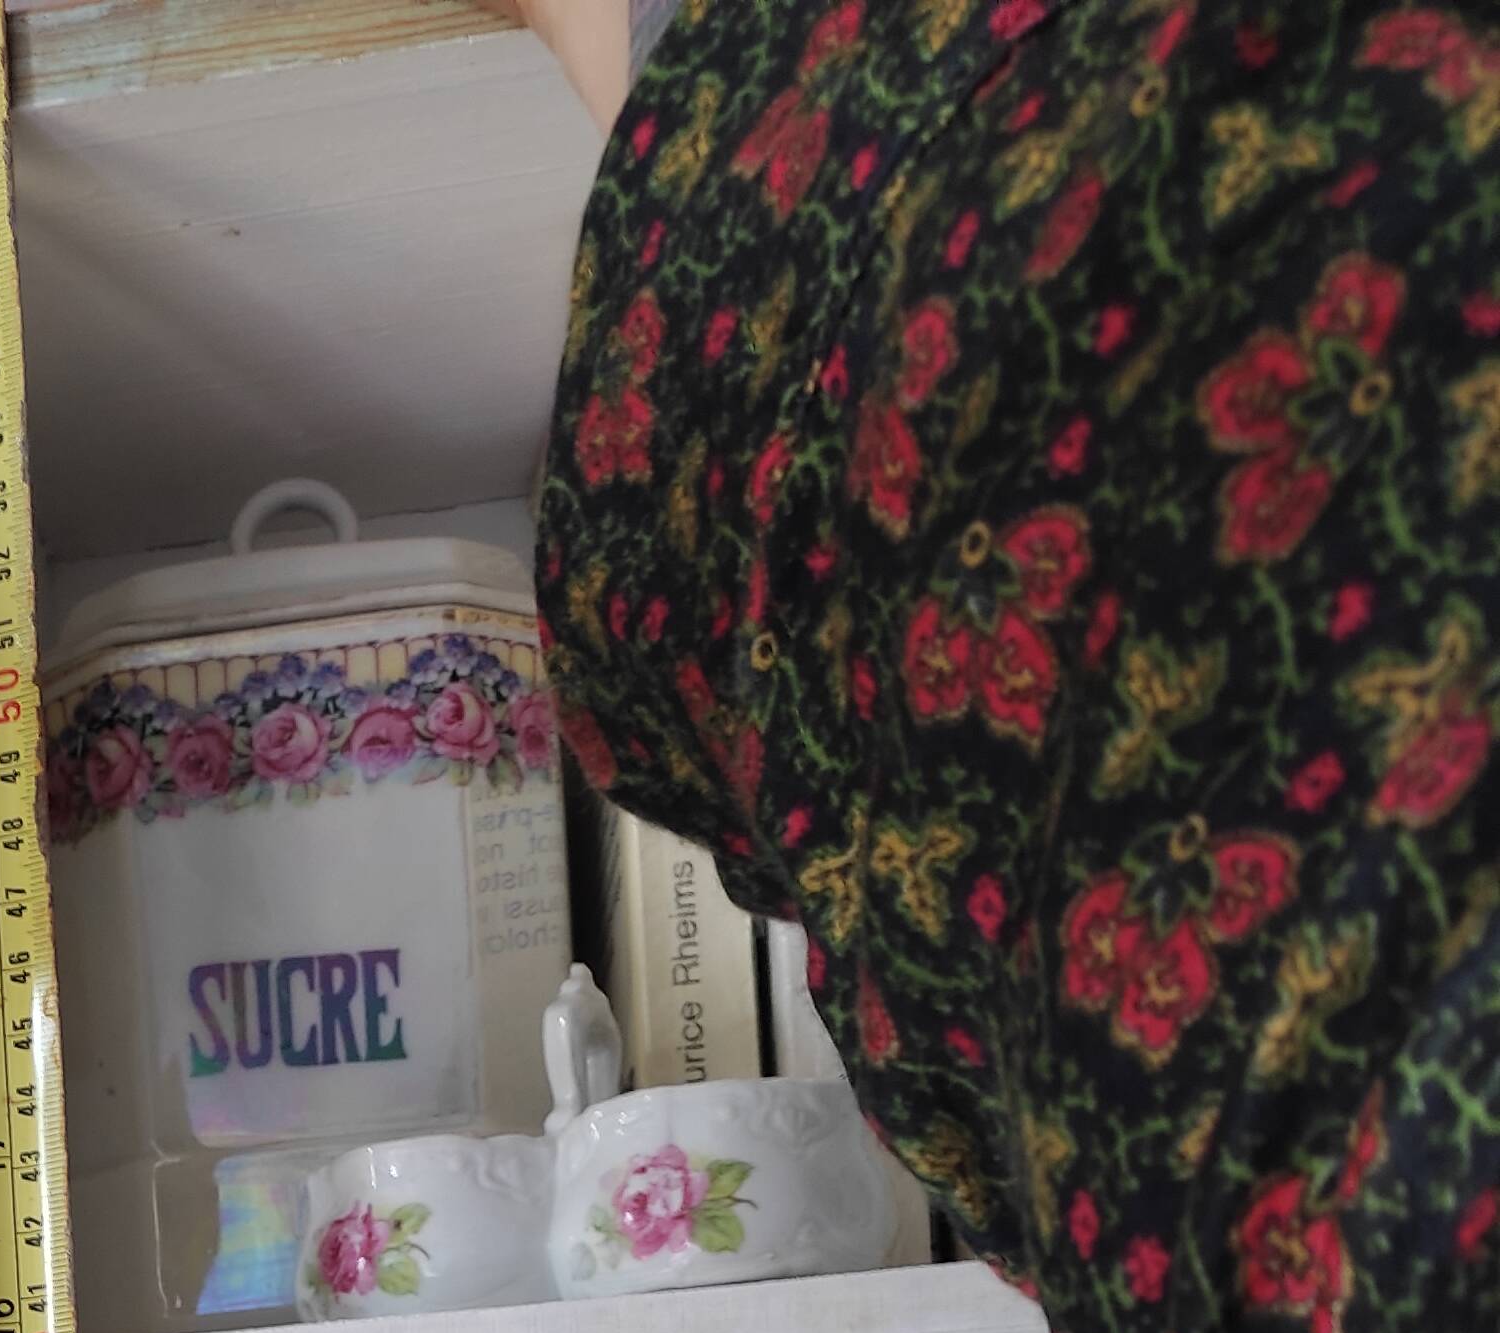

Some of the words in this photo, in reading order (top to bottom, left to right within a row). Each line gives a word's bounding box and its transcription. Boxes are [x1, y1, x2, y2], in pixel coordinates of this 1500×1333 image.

[0, 751, 20, 784] 49
[2, 817, 24, 851] 48
[5, 887, 27, 918] 47
[670, 859, 701, 986] Rheims
[9, 951, 30, 985] 46
[189, 949, 407, 1078] SUCRE
[13, 1017, 33, 1050] 45
[16, 1084, 36, 1117] 44
[20, 1152, 40, 1182] 43
[24, 1216, 44, 1248] 42
[28, 1284, 47, 1313] 41
